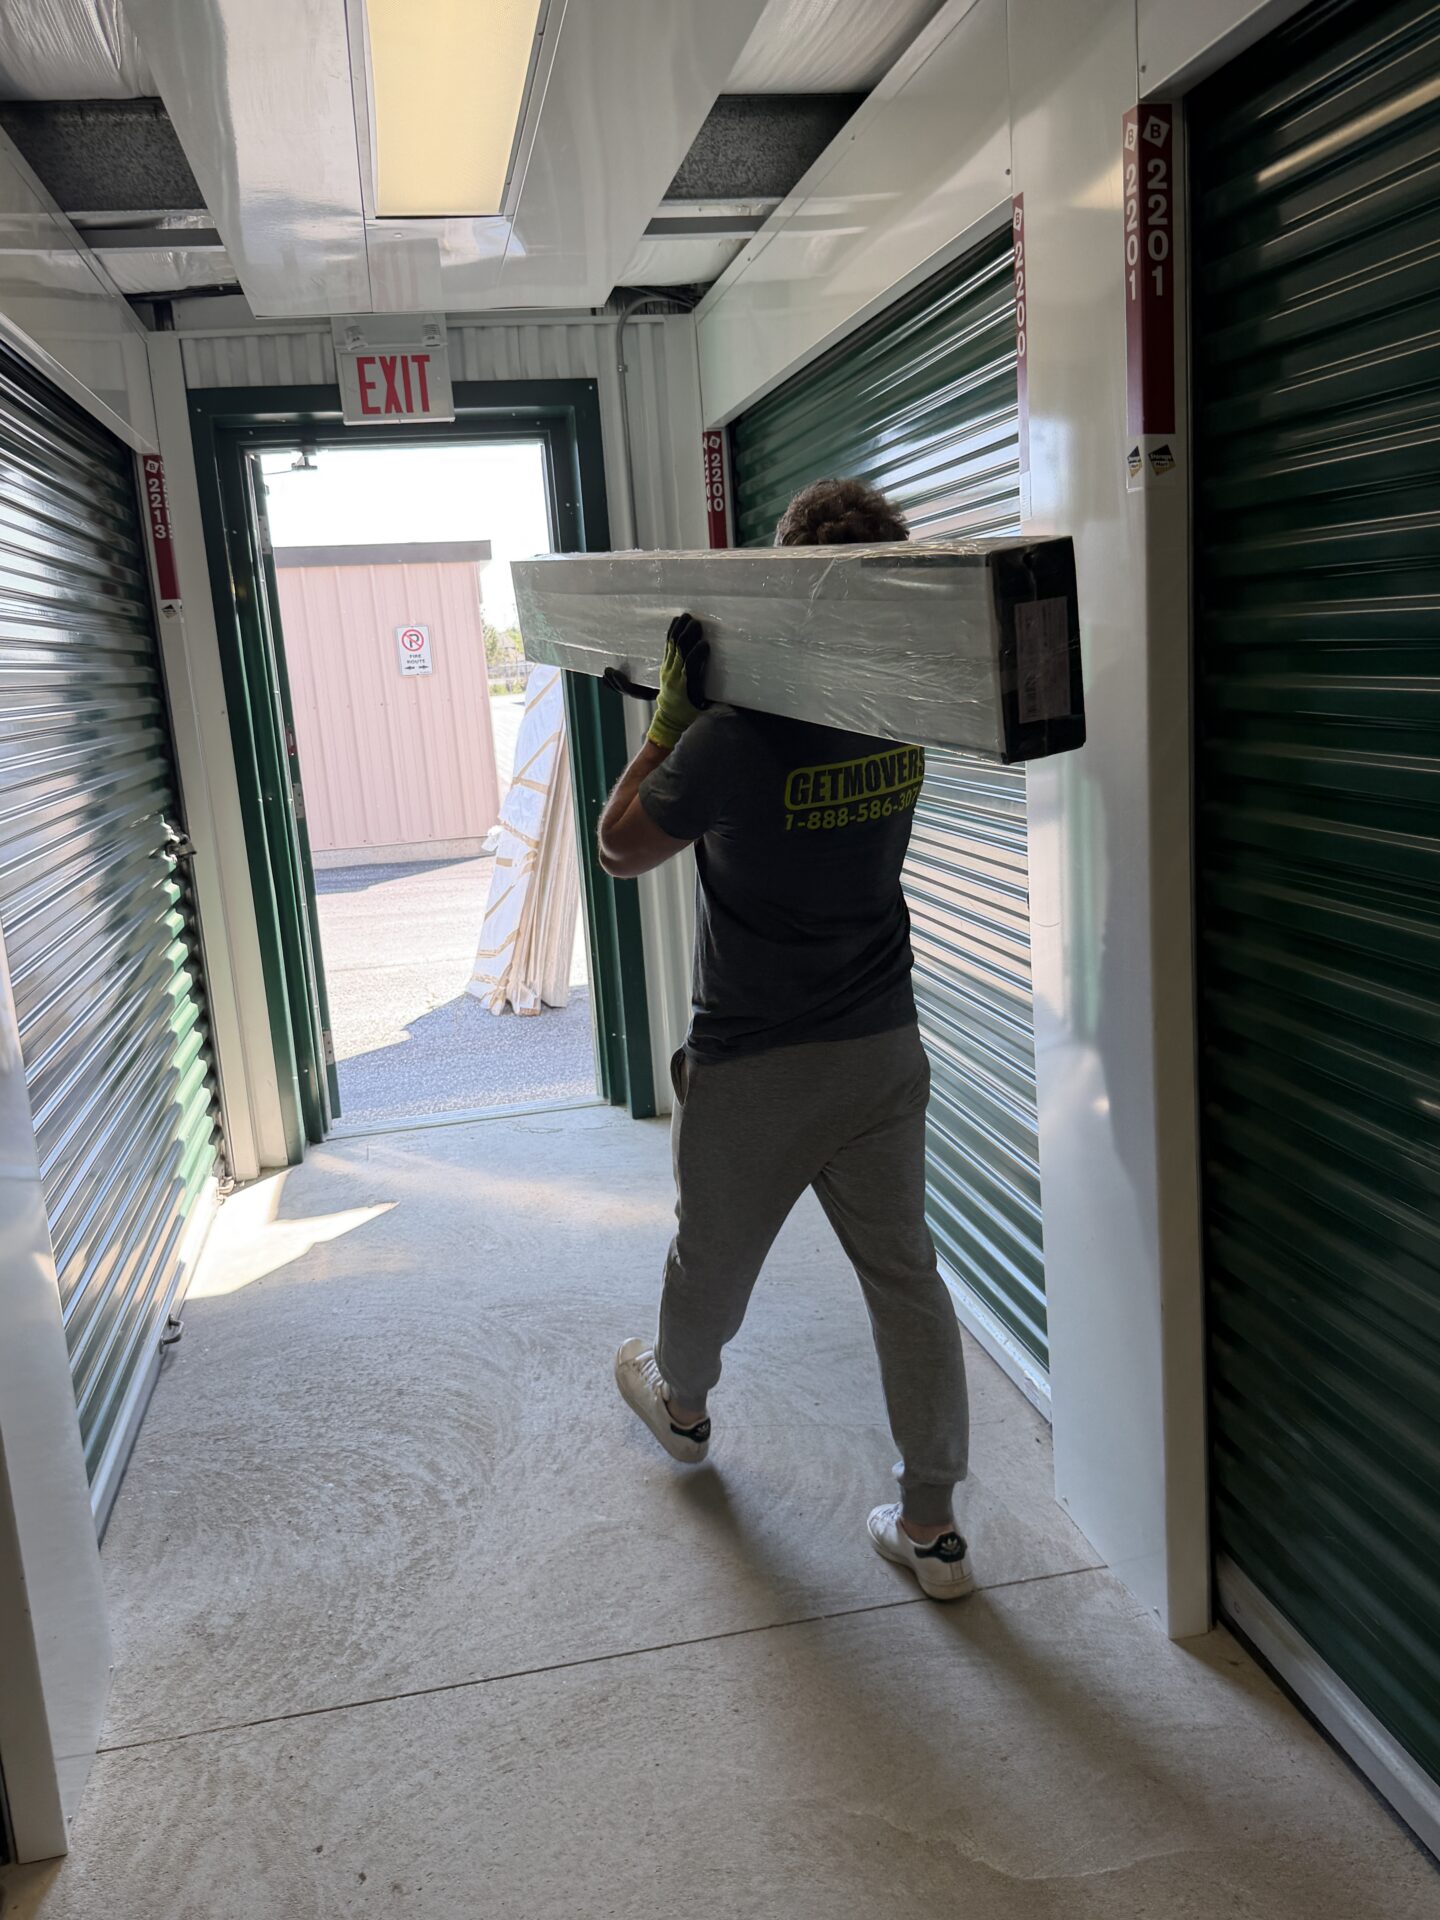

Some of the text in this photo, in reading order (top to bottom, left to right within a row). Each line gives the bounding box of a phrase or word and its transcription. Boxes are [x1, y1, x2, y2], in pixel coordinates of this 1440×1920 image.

[1126, 163, 1139, 301] 2201
[1147, 123, 1169, 297] B 2201
[1015, 241, 1026, 357] 2200
[356, 354, 430, 415] EXIT
[148, 478, 167, 539] 2213
[711, 453, 724, 512] 2200
[790, 747, 925, 806] GETMOVERS
